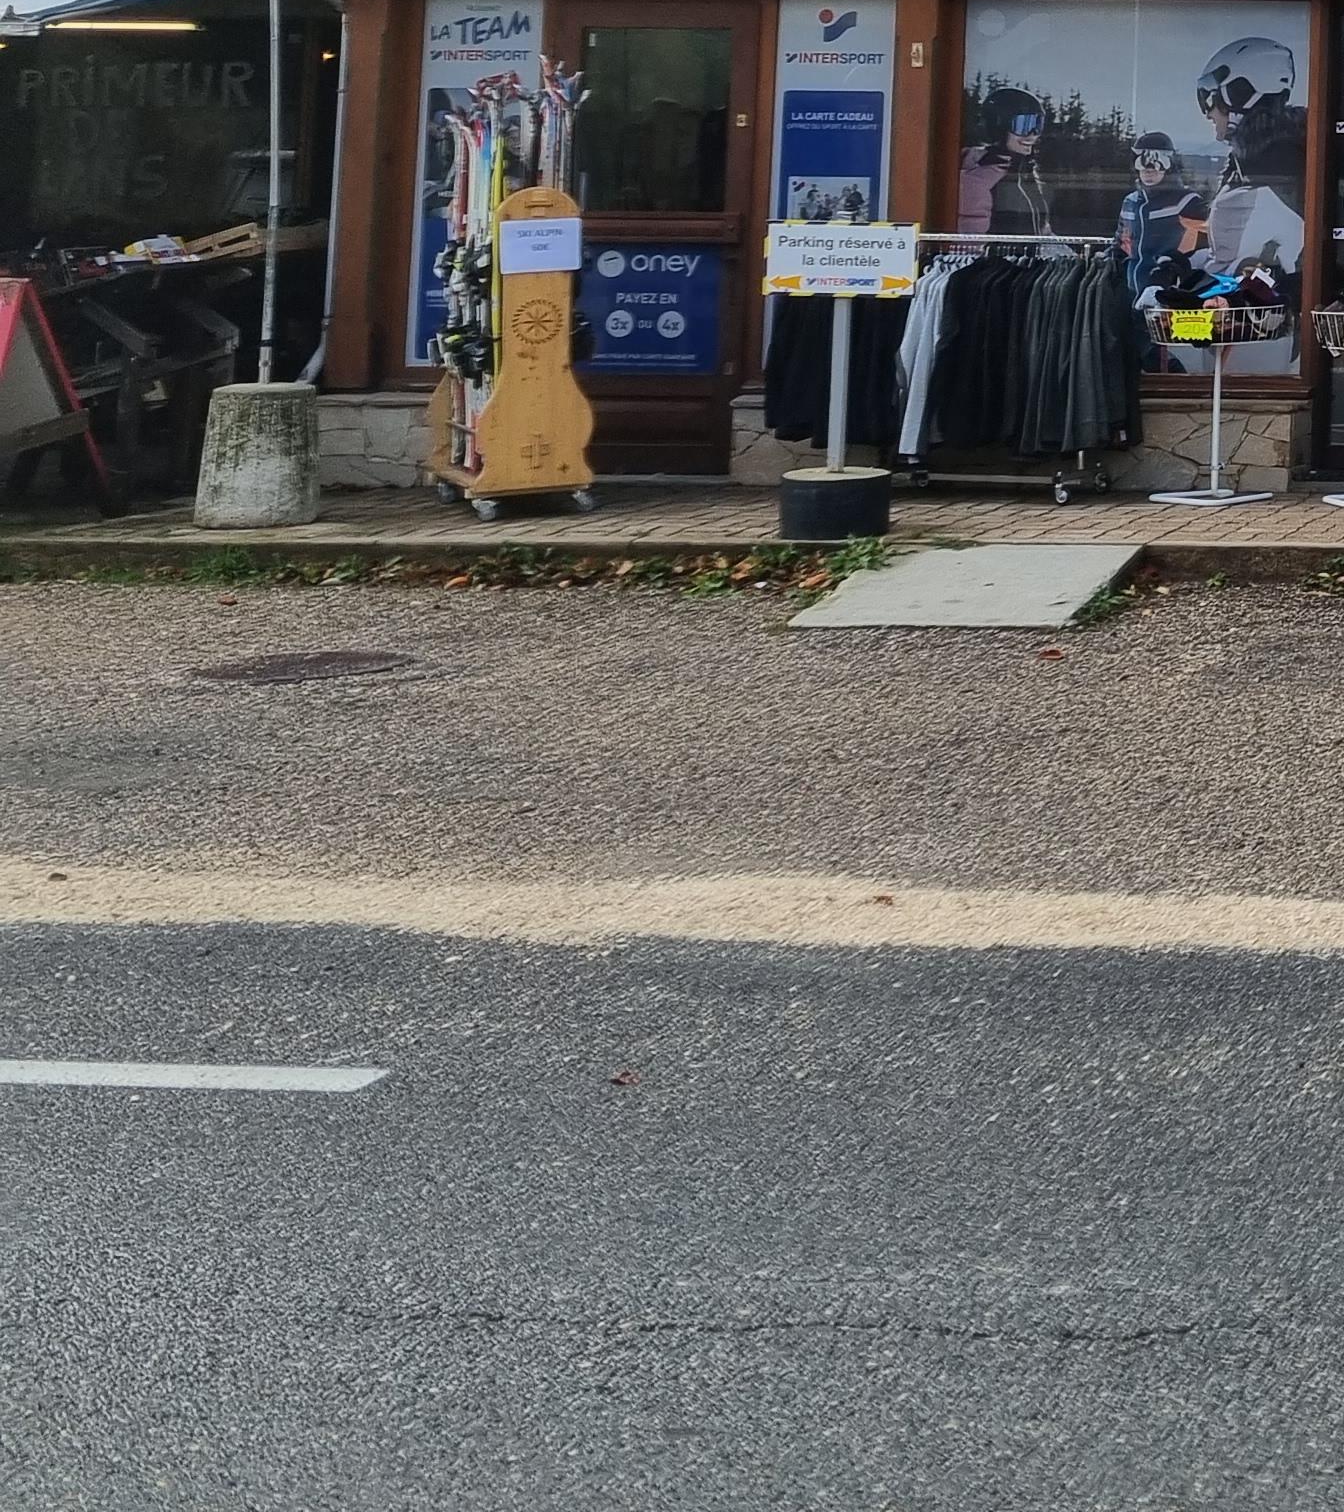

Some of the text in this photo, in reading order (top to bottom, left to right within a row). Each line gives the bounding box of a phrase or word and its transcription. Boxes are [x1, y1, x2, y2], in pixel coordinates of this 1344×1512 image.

[430, 10, 531, 45] LA TEAM
[443, 50, 532, 61] INTERSPORT
[799, 52, 885, 64] INTERSPORT
[791, 112, 874, 121] LA CARTE CADEAU
[778, 235, 906, 250] Parking réservé à
[631, 253, 701, 277] oney
[802, 254, 881, 267] la clientèle
[816, 277, 878, 286] INTERSPORT
[615, 292, 679, 304] PAYEZ EN
[611, 317, 630, 330] 3x
[662, 319, 681, 331] 4x
